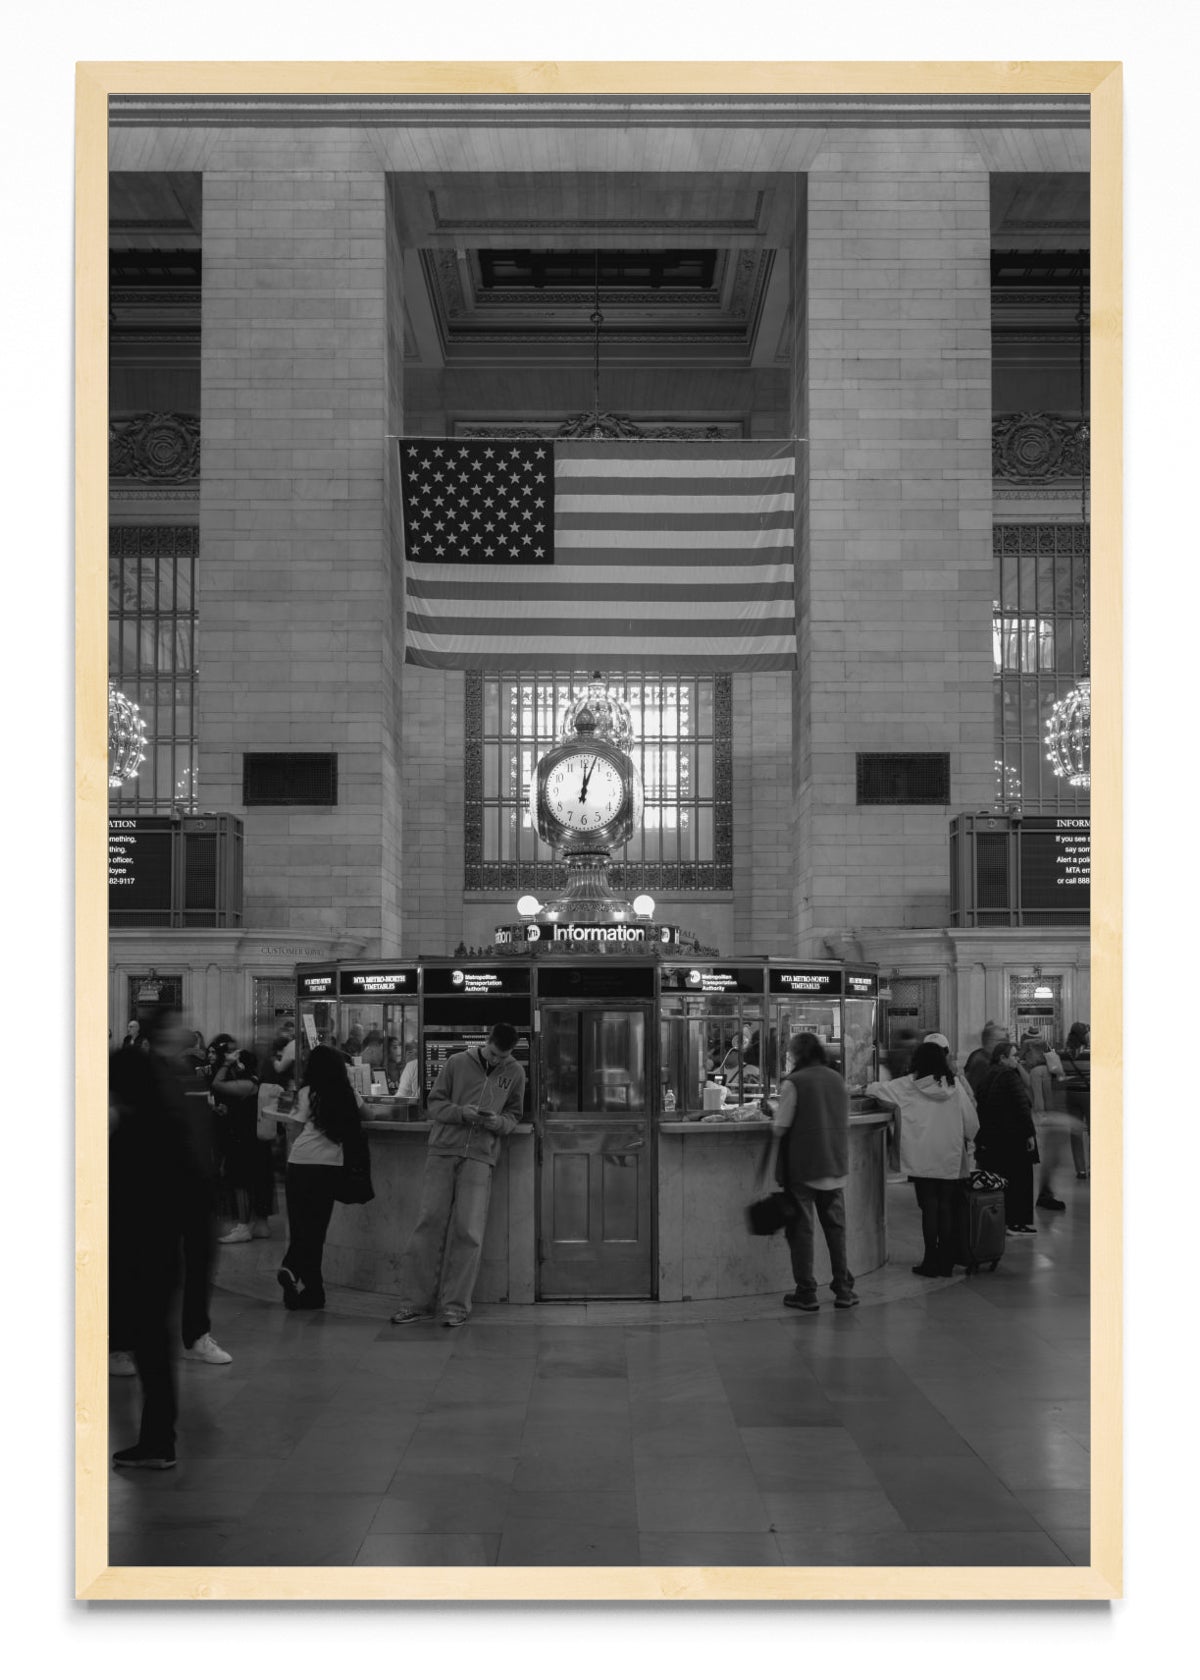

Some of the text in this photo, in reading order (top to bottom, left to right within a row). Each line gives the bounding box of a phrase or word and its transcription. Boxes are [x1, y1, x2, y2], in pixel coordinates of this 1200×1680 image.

[606, 771, 613, 782] 2
[553, 787, 559, 797] 9
[556, 801, 563, 812] 8
[605, 801, 612, 812] 4
[567, 810, 573, 822] 7
[581, 814, 588, 826] 6
[594, 811, 602, 823] 5
[554, 924, 645, 942] Information
[498, 1076, 512, 1090] W
